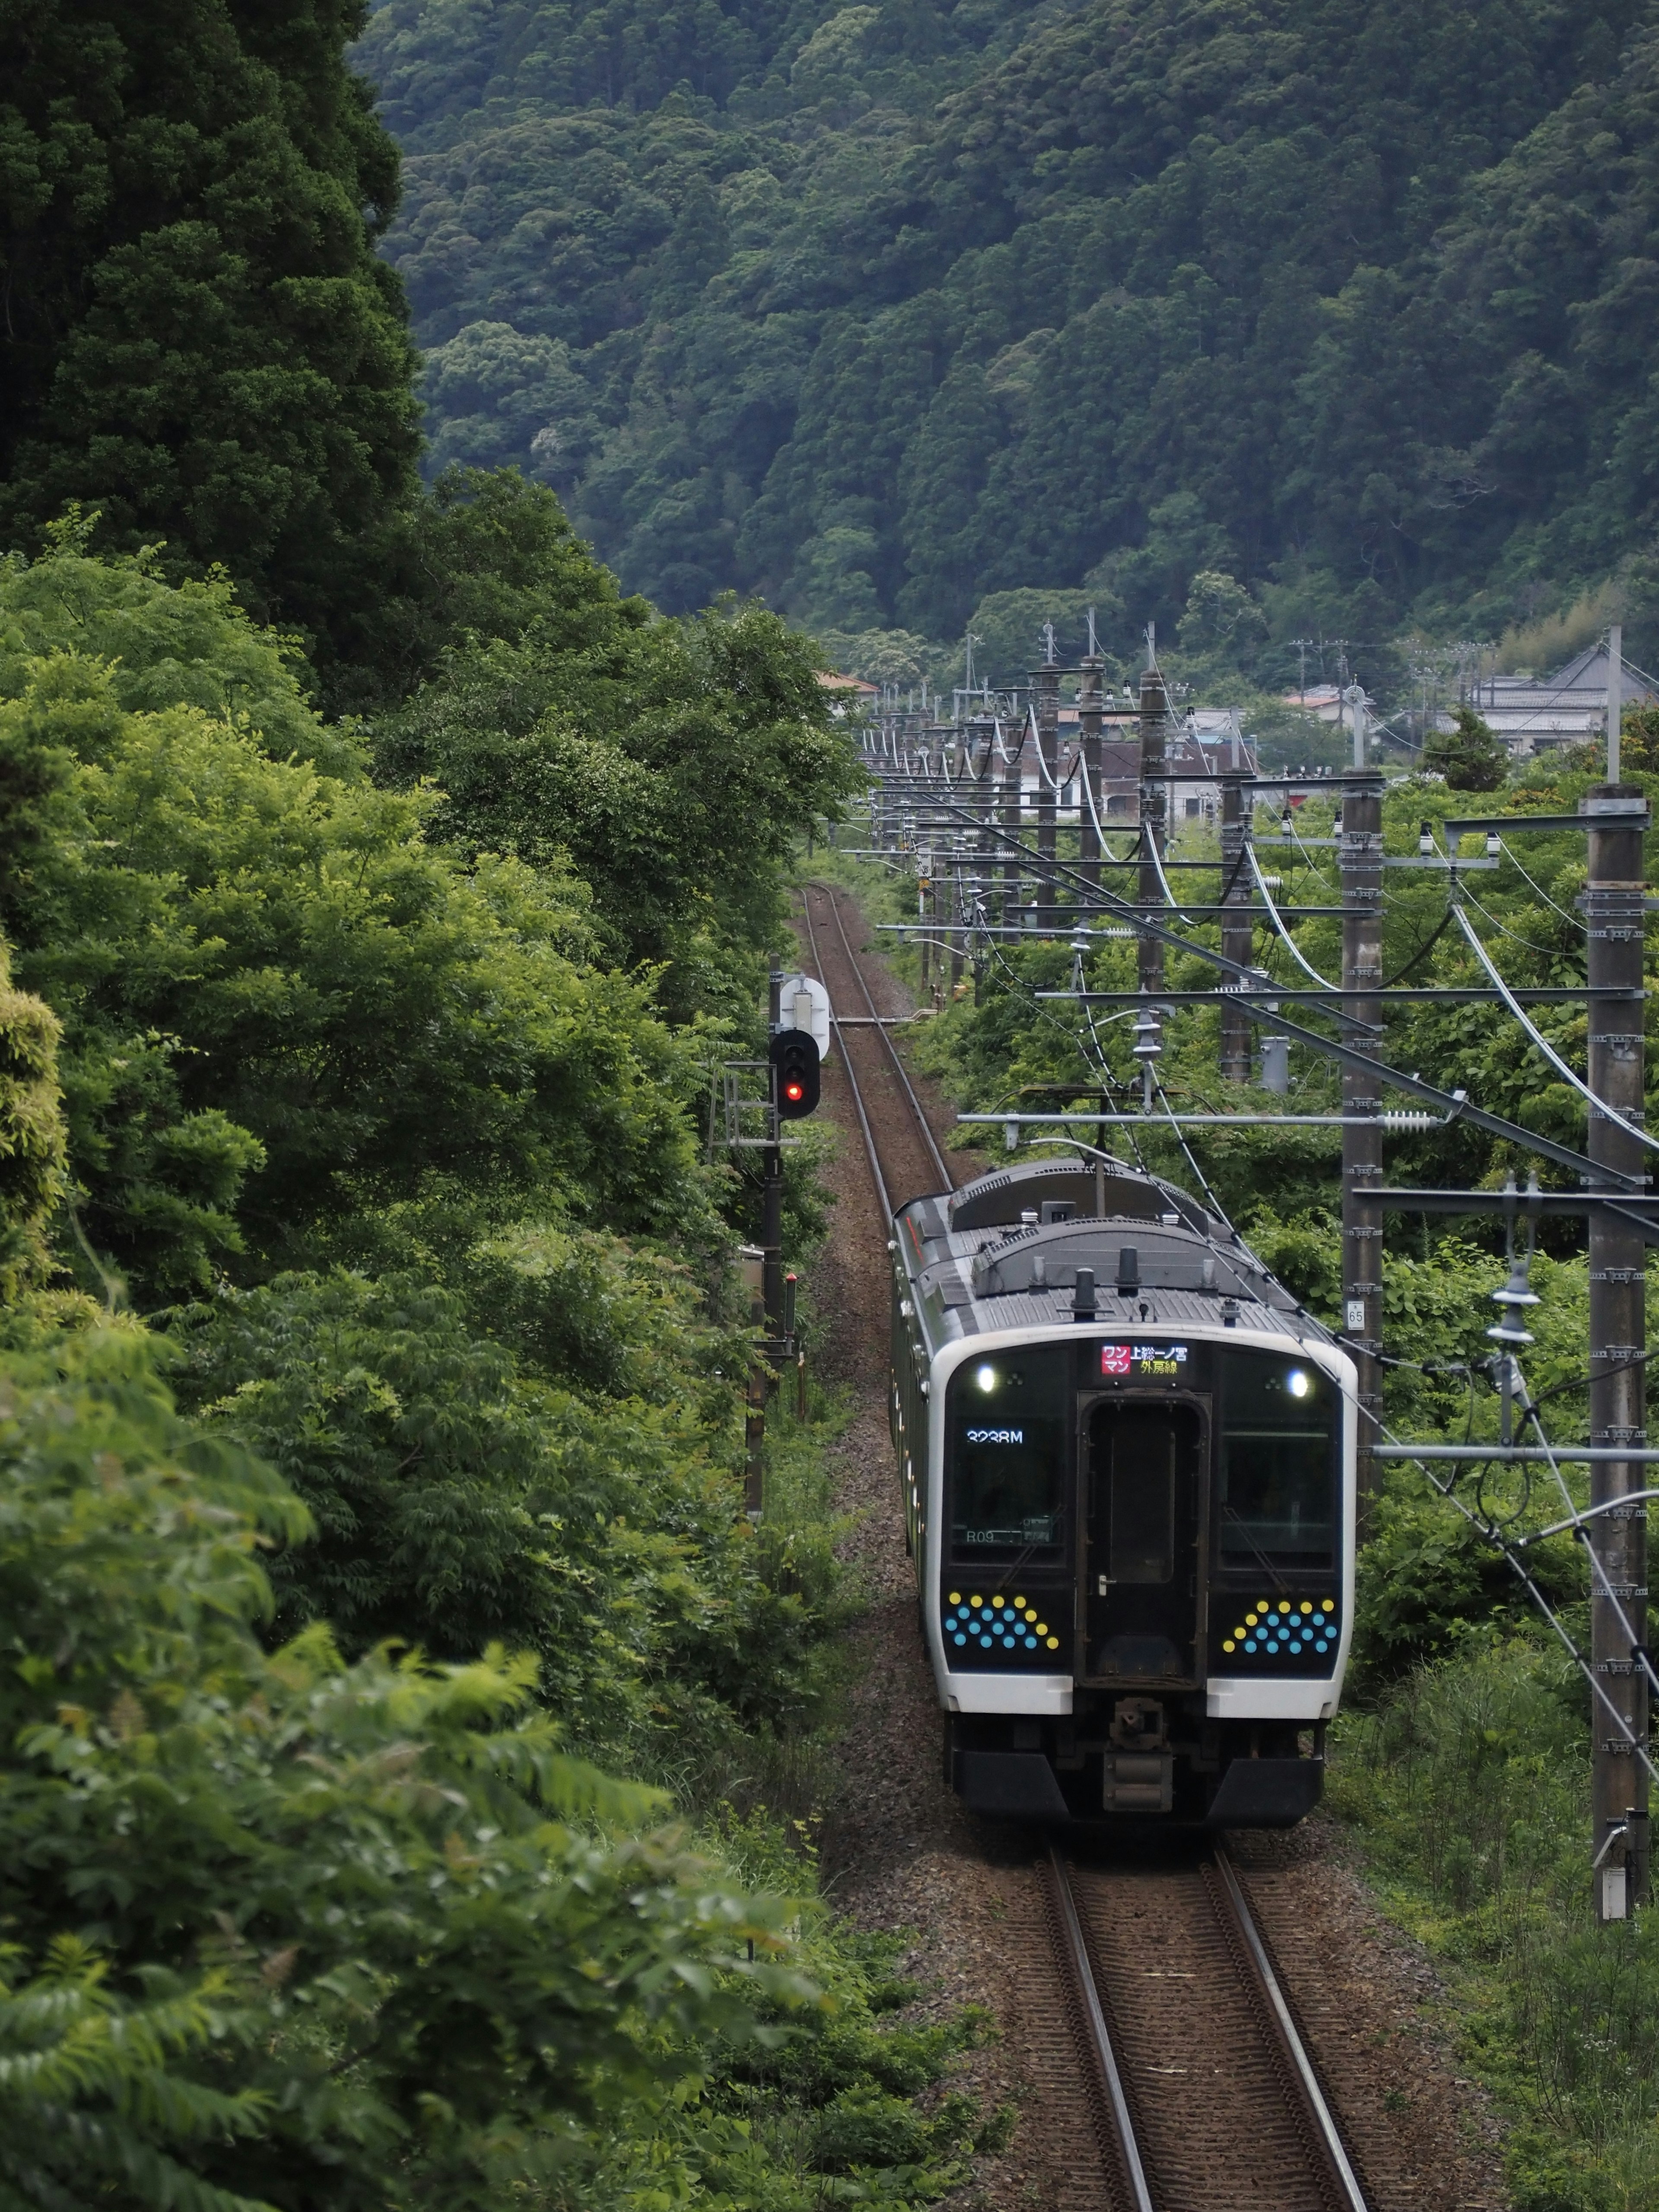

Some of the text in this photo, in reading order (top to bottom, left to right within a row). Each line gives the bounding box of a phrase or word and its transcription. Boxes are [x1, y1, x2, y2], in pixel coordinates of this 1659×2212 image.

[1350, 1311, 1362, 1322] 65
[1104, 1346, 1127, 1358] ワン
[1130, 1347, 1188, 1361] 上総一ノ宮
[1105, 1361, 1128, 1373] マン
[1141, 1361, 1178, 1374] 外房線
[967, 1431, 1023, 1444] 3238M
[967, 1531, 994, 1543] R09
